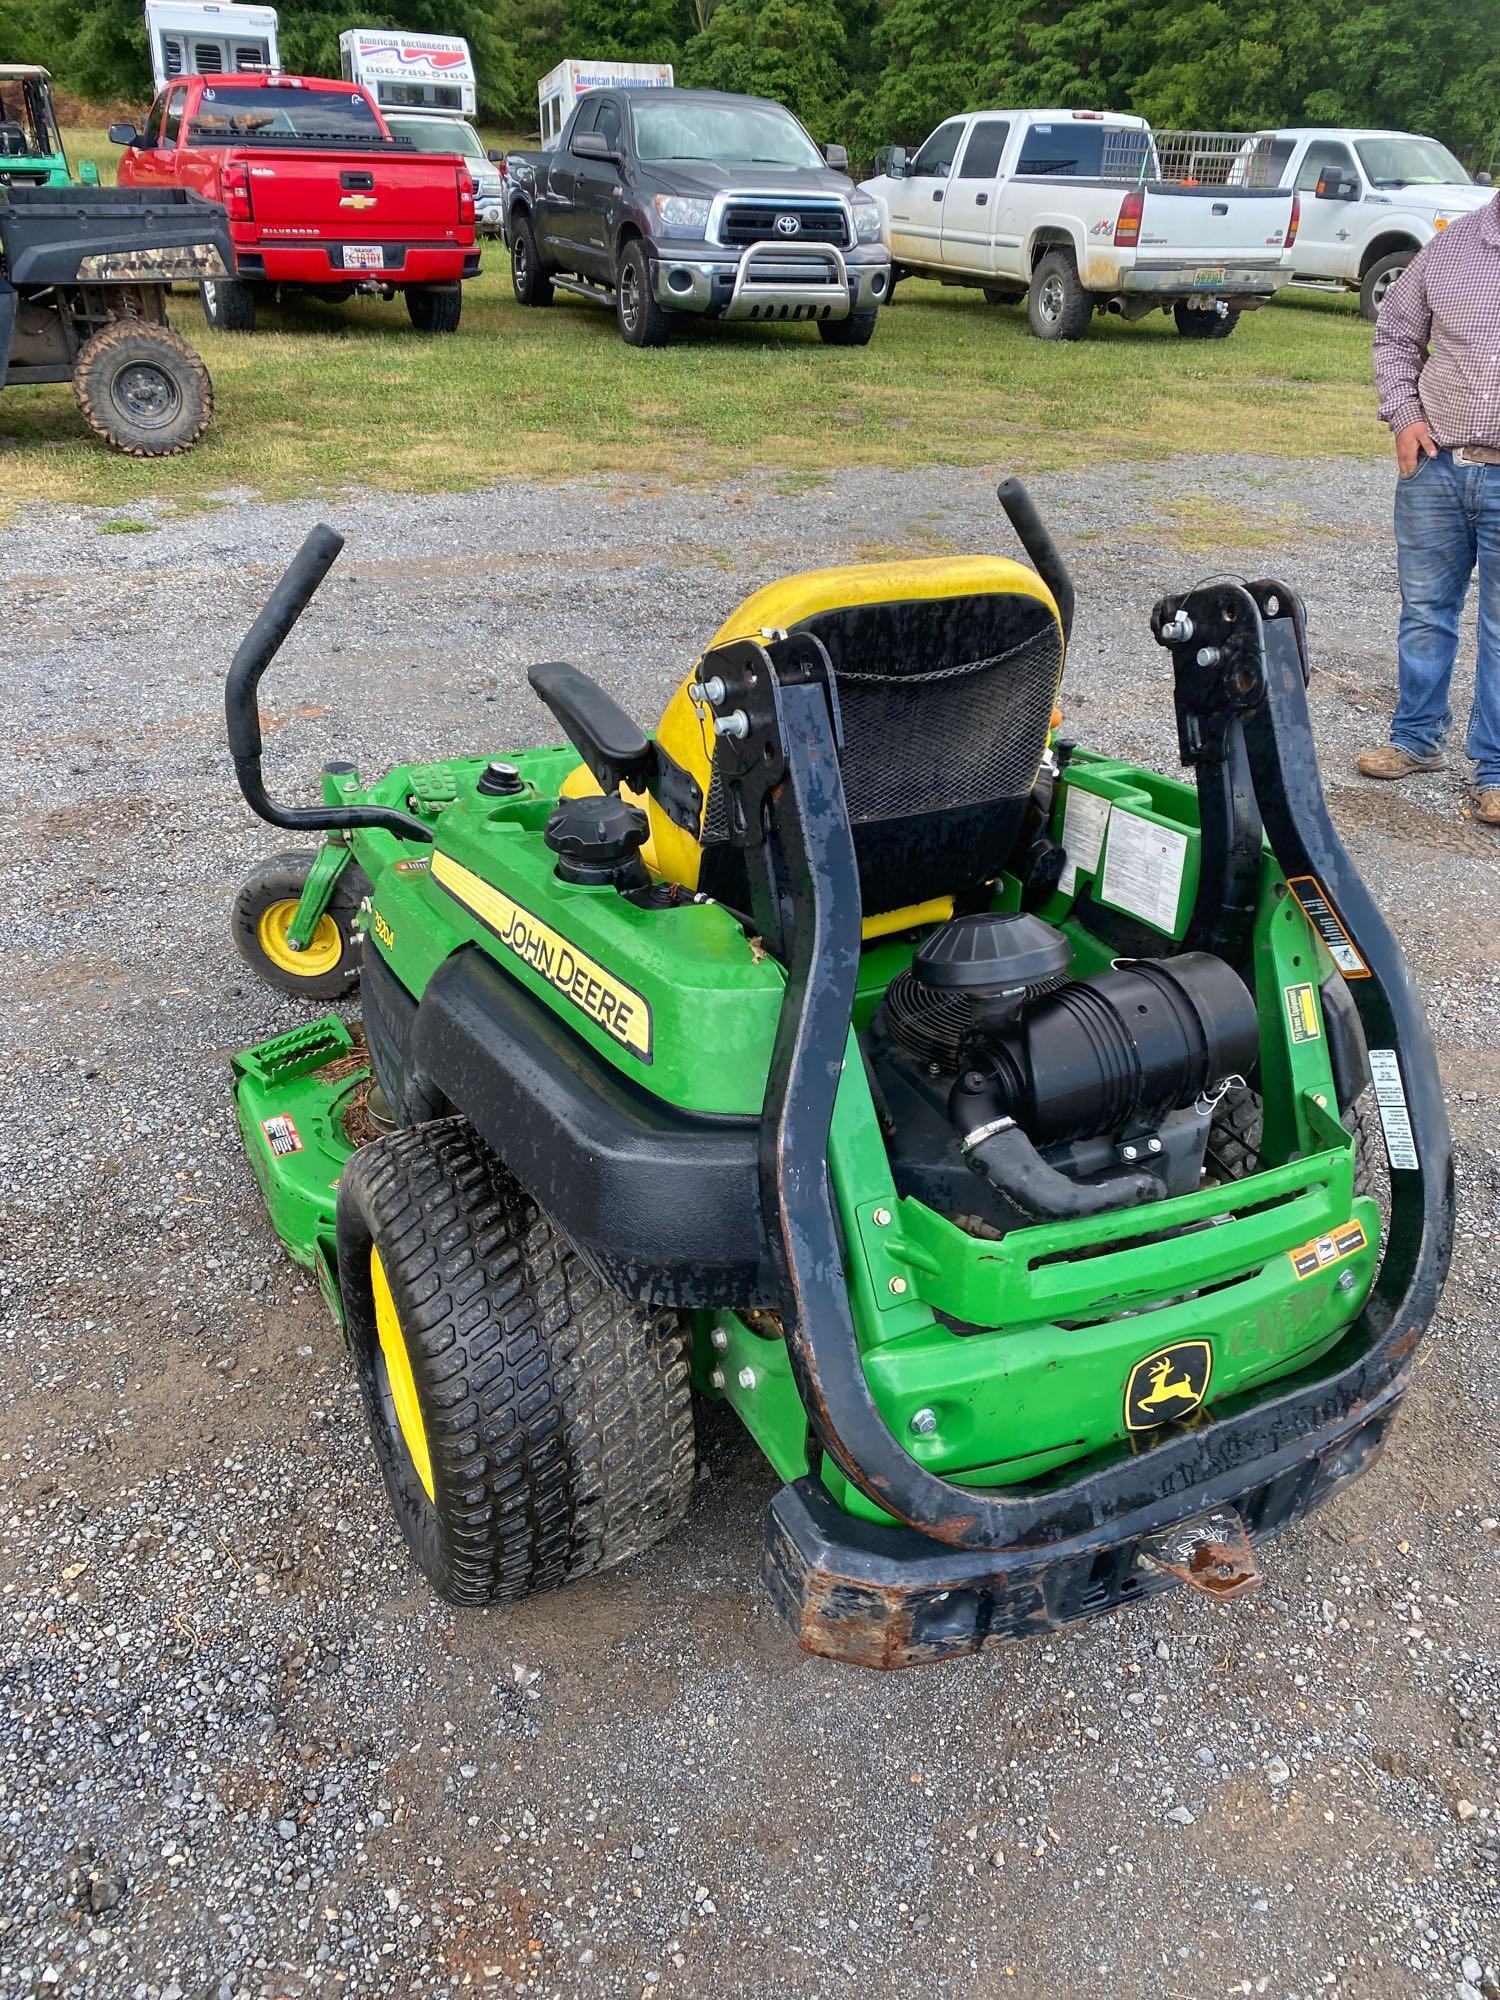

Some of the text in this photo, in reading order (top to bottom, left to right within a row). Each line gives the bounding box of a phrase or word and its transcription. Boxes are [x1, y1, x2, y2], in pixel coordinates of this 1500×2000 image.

[359, 36, 398, 46] American
[366, 66, 468, 79] 866-789-5169
[576, 74, 610, 86] American
[102, 258, 208, 272] RANGER
[502, 910, 634, 1036] JOHN DEERE
